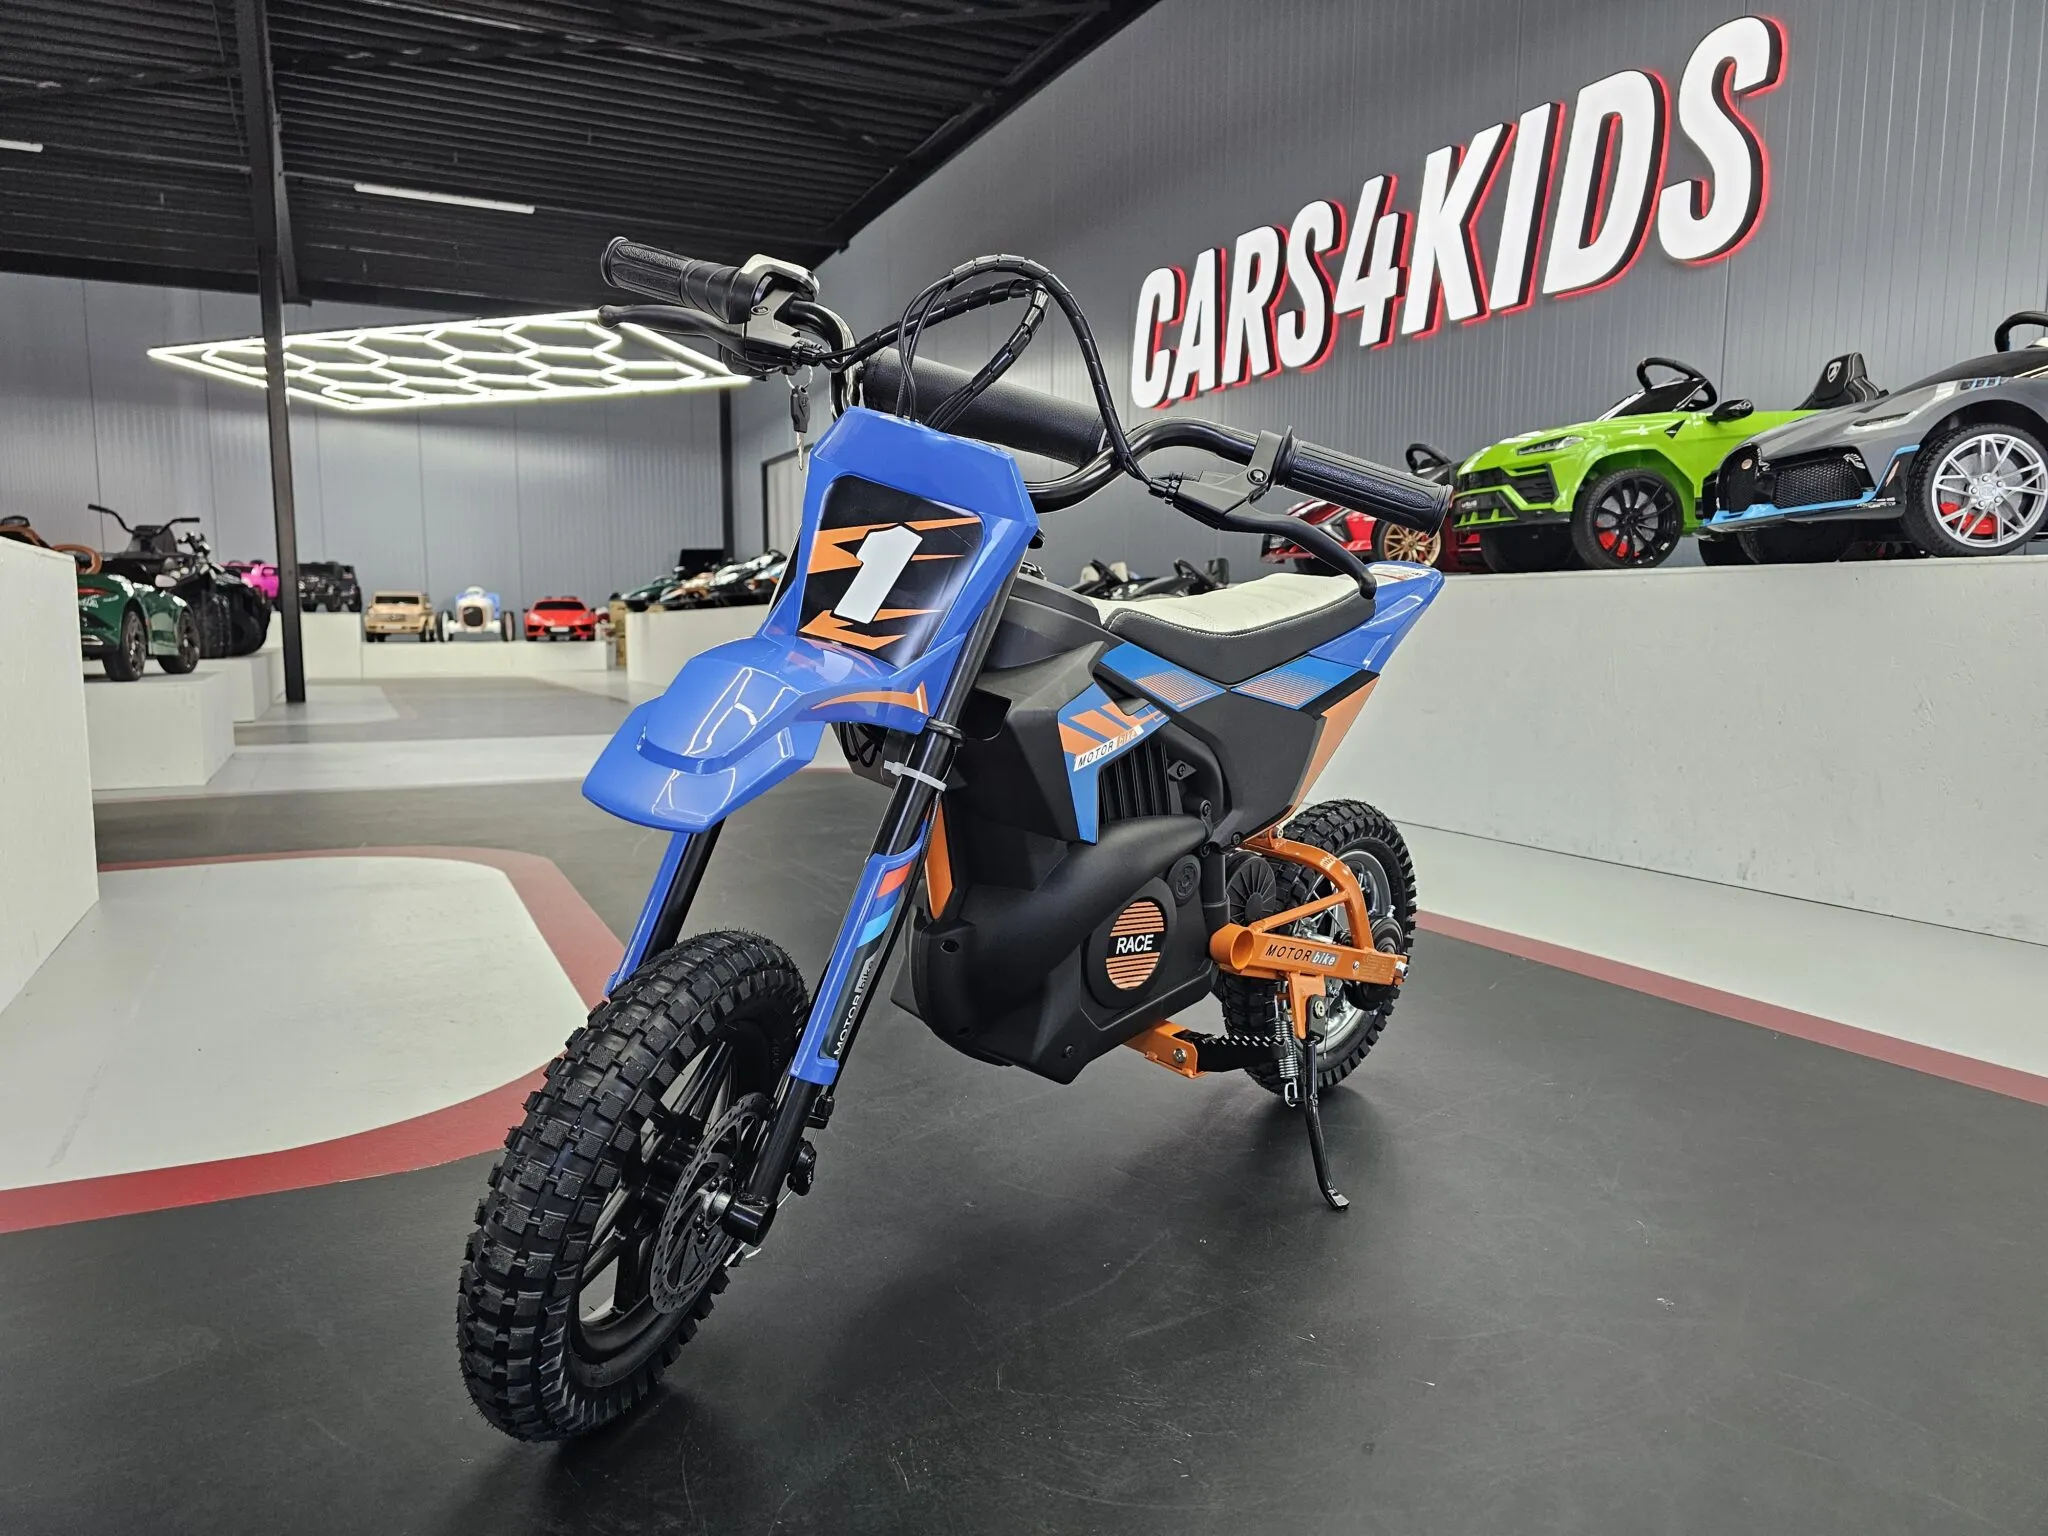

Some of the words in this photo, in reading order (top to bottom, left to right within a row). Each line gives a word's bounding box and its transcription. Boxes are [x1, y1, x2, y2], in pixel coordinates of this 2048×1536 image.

[1131, 15, 1783, 409] CARS4KIDS
[834, 525, 923, 624] 1
[1115, 933, 1155, 955] RACE
